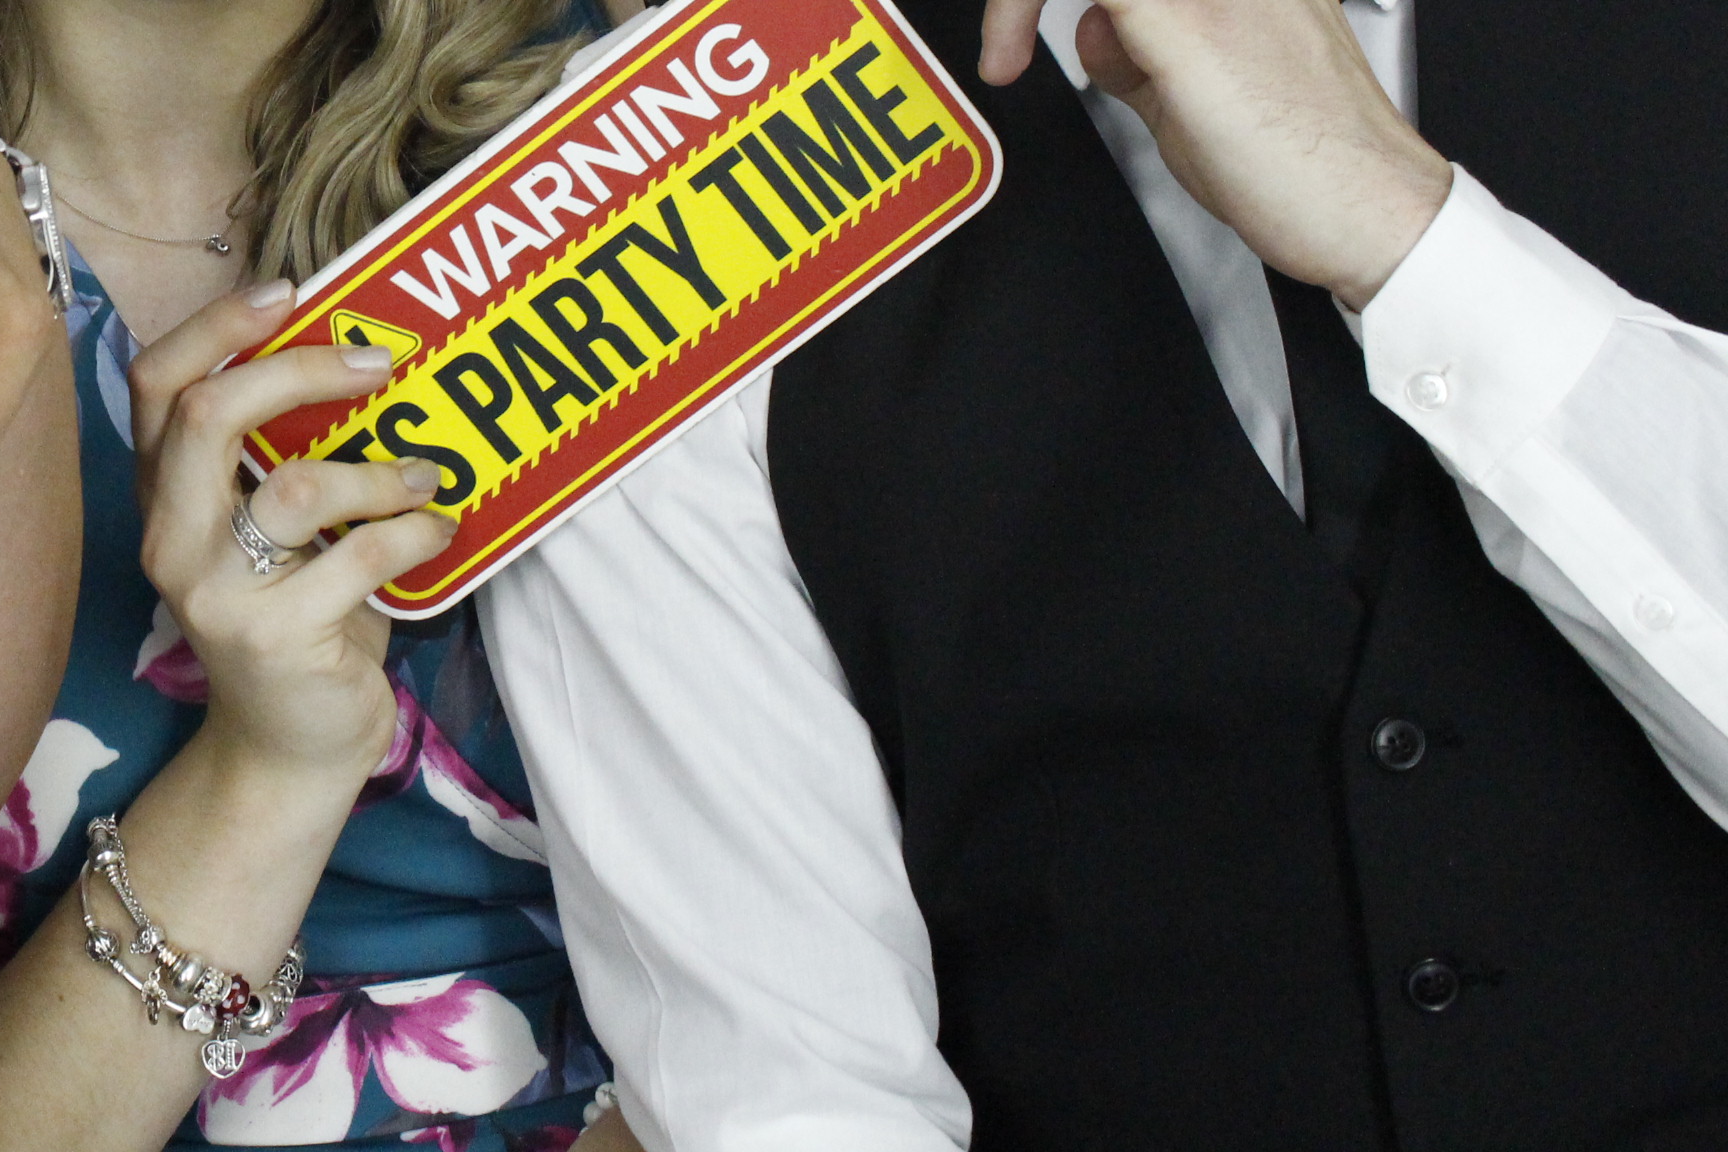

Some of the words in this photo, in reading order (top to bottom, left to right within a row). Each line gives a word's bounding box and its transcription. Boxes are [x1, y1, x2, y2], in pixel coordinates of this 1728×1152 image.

[389, 23, 770, 321] WARNING
[431, 194, 727, 465] PARTY
[687, 41, 945, 262] TIME
